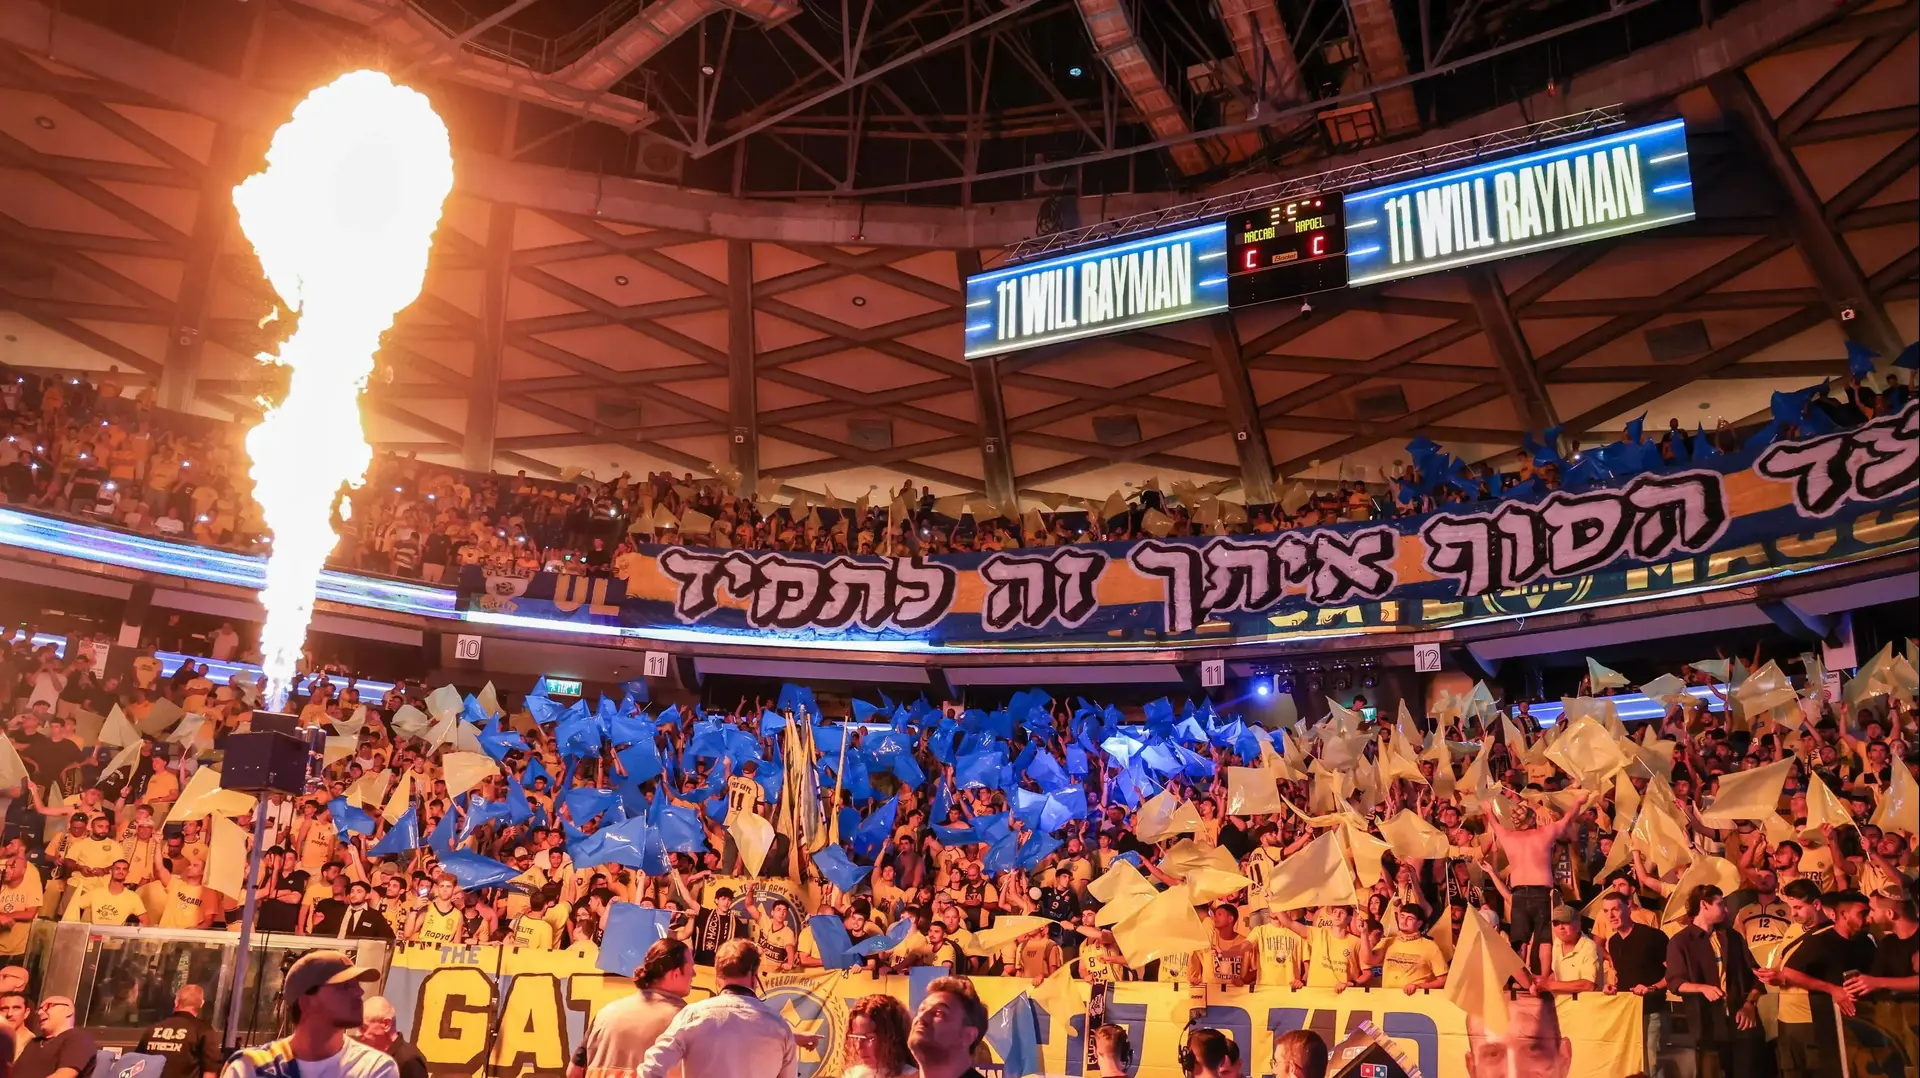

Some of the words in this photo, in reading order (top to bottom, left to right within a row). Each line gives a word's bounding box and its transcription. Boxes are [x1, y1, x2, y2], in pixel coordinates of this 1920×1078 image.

[1384, 195, 1414, 264] 11
[1416, 177, 1494, 258] WILL
[1495, 143, 1644, 243] RAYMAN
[1244, 226, 1276, 244] MACCABI
[1295, 217, 1325, 233] HAPOEL
[996, 278, 1017, 341] 11
[1021, 265, 1077, 336] WILL
[1081, 241, 1192, 325] RAYMAN
[982, 549, 1108, 631] זה
[458, 638, 481, 658] 10
[649, 656, 665, 676] 11
[1416, 649, 1440, 671] 12
[1205, 664, 1223, 685] 11
[1759, 918, 1770, 928] 12
[439, 946, 482, 965] THE
